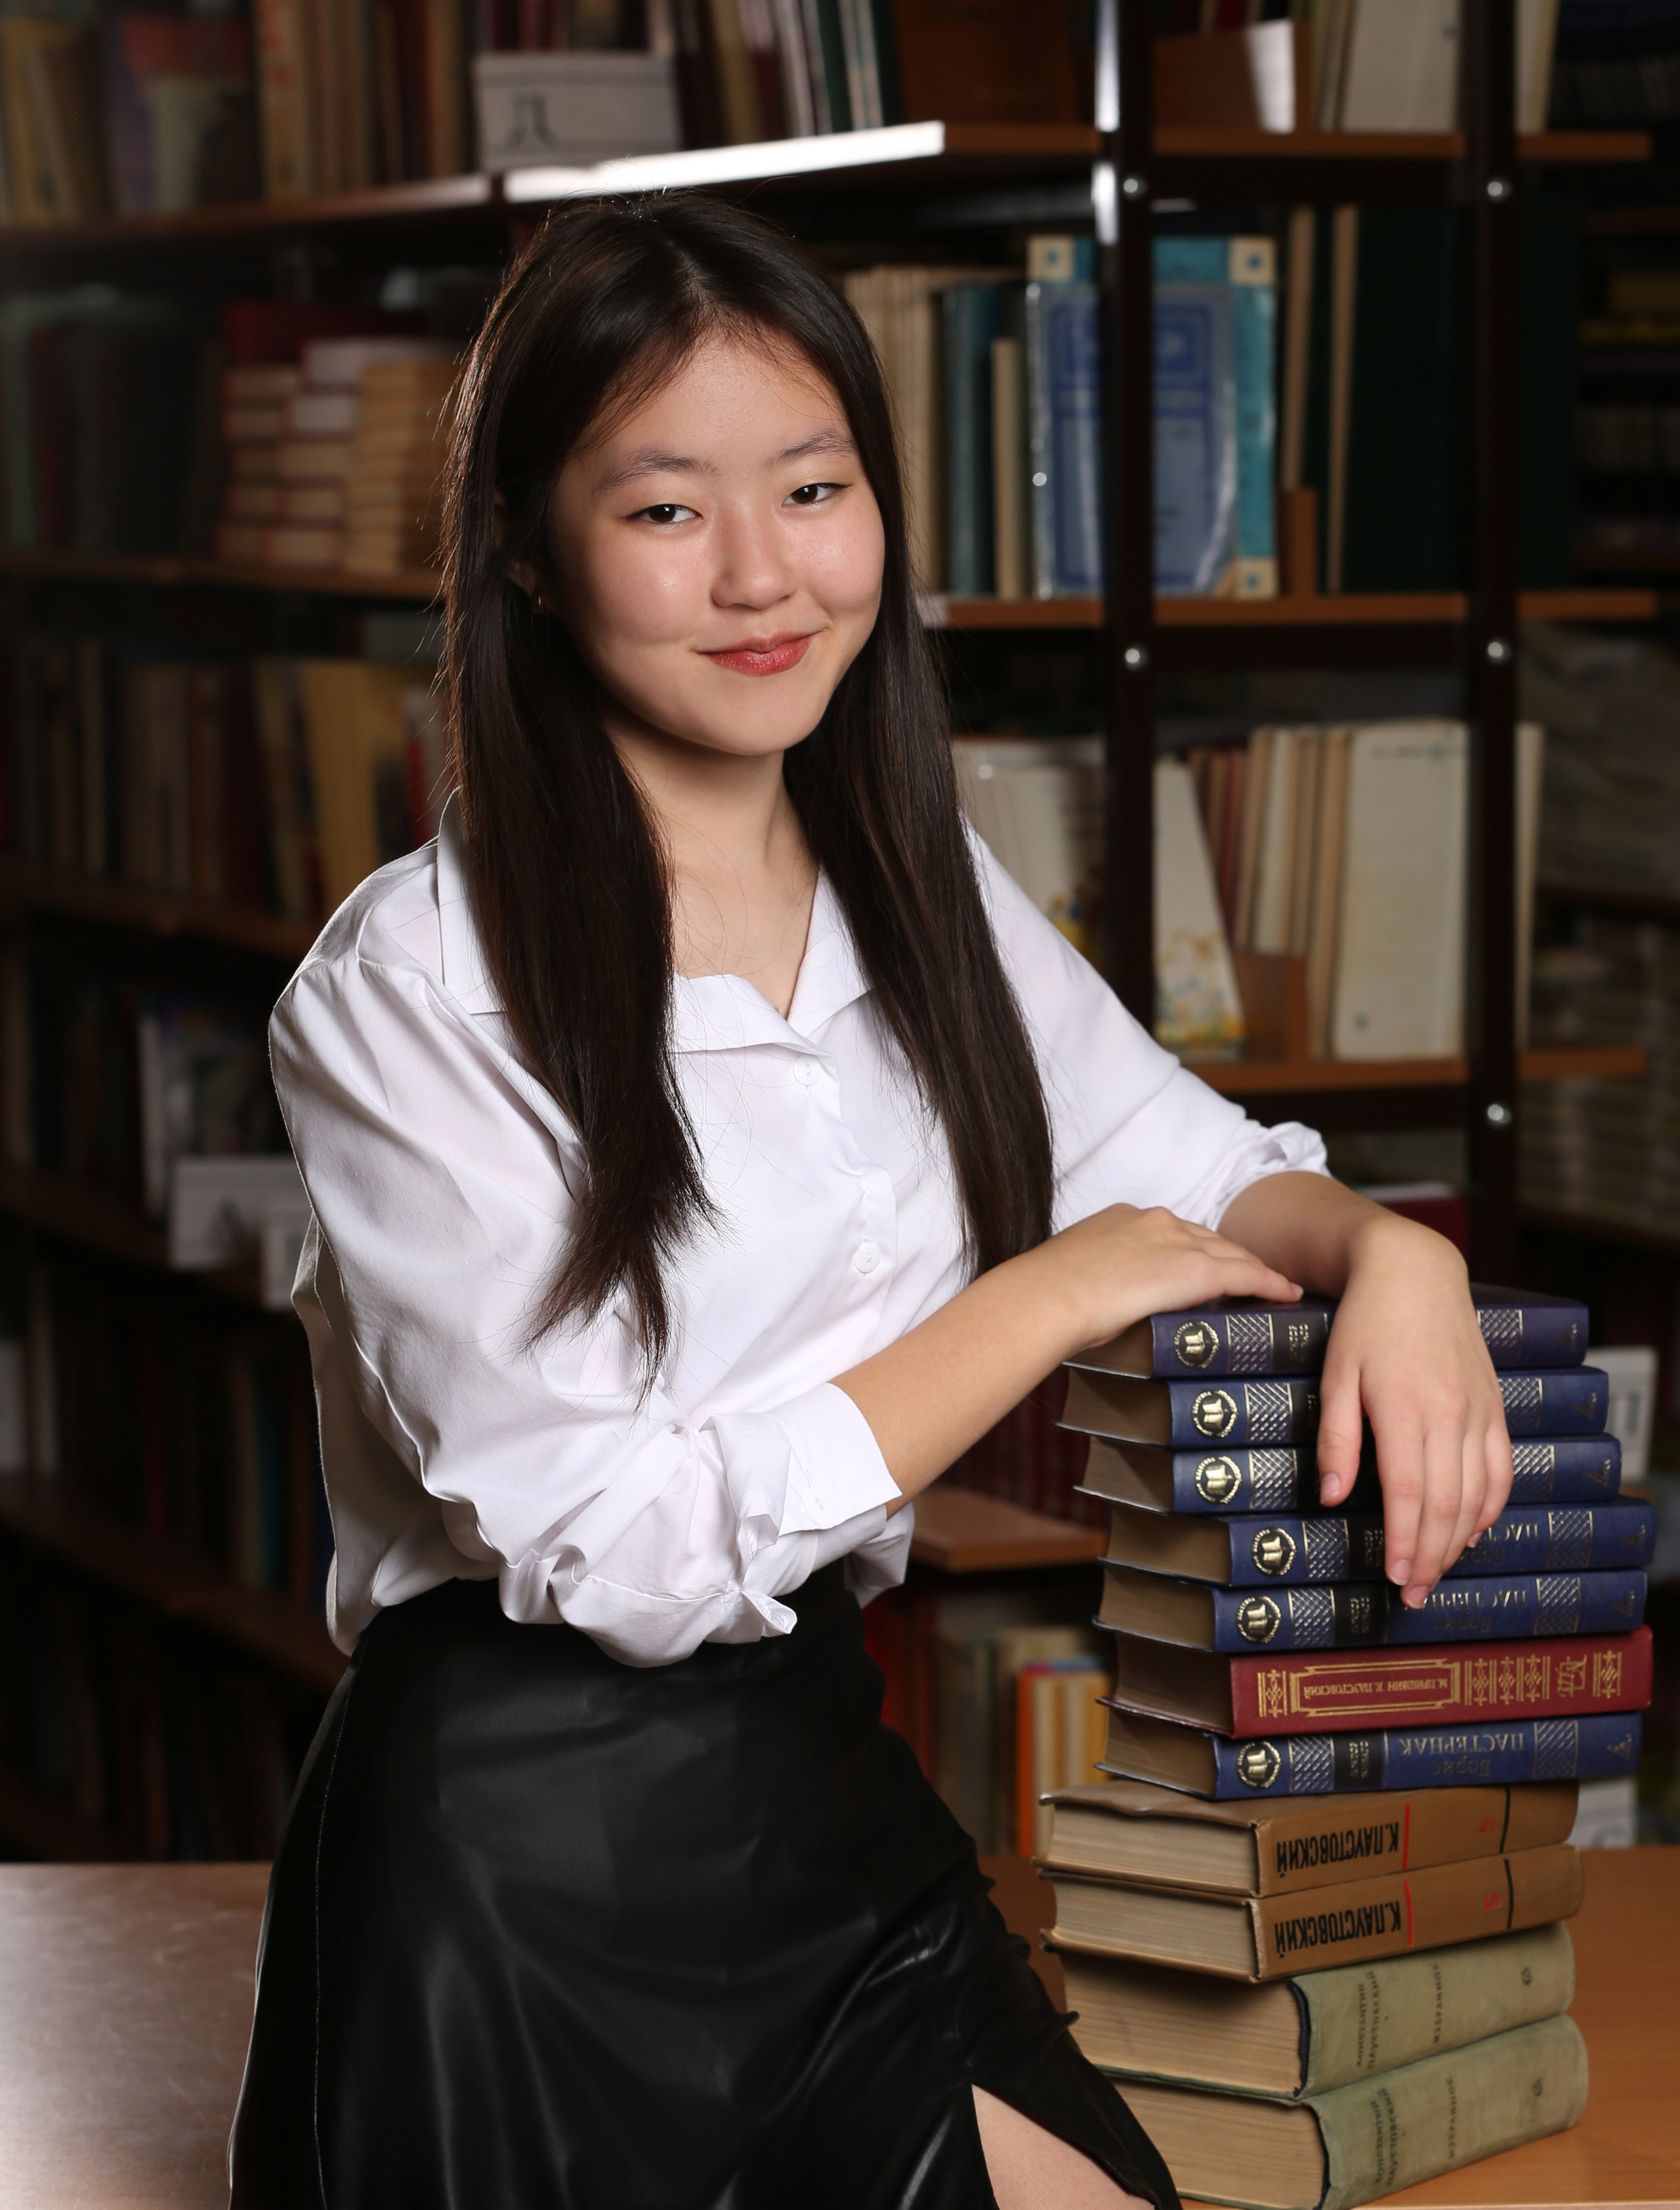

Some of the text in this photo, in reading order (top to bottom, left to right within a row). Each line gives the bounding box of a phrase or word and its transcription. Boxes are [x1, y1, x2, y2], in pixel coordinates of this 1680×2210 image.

[1404, 1590, 1528, 1611] ПАСТЕРН
[1303, 1682, 1373, 1699] ПАУСТОВСКИЙ
[1387, 1679, 1436, 1692] ПРИШВИН
[1398, 1733, 1524, 1756] ПАСТЕРНАК
[1433, 1757, 1491, 1776] Борис
[1479, 1818, 1496, 1834] 5
[1484, 1893, 1502, 1910] 5
[1433, 1963, 1442, 2043] ИЗБРАННОЕ
[1356, 1982, 1367, 2067] КОНСТАНТИН
[1366, 1970, 1379, 2069] ПАУСТОВСКИЙ
[1446, 2075, 1456, 2159] ИЗБРАННОЕ
[1370, 2099, 1384, 2184] КОНСТАНТИН
[1377, 2087, 1398, 2187] ПАУСТОВСКИЙ
